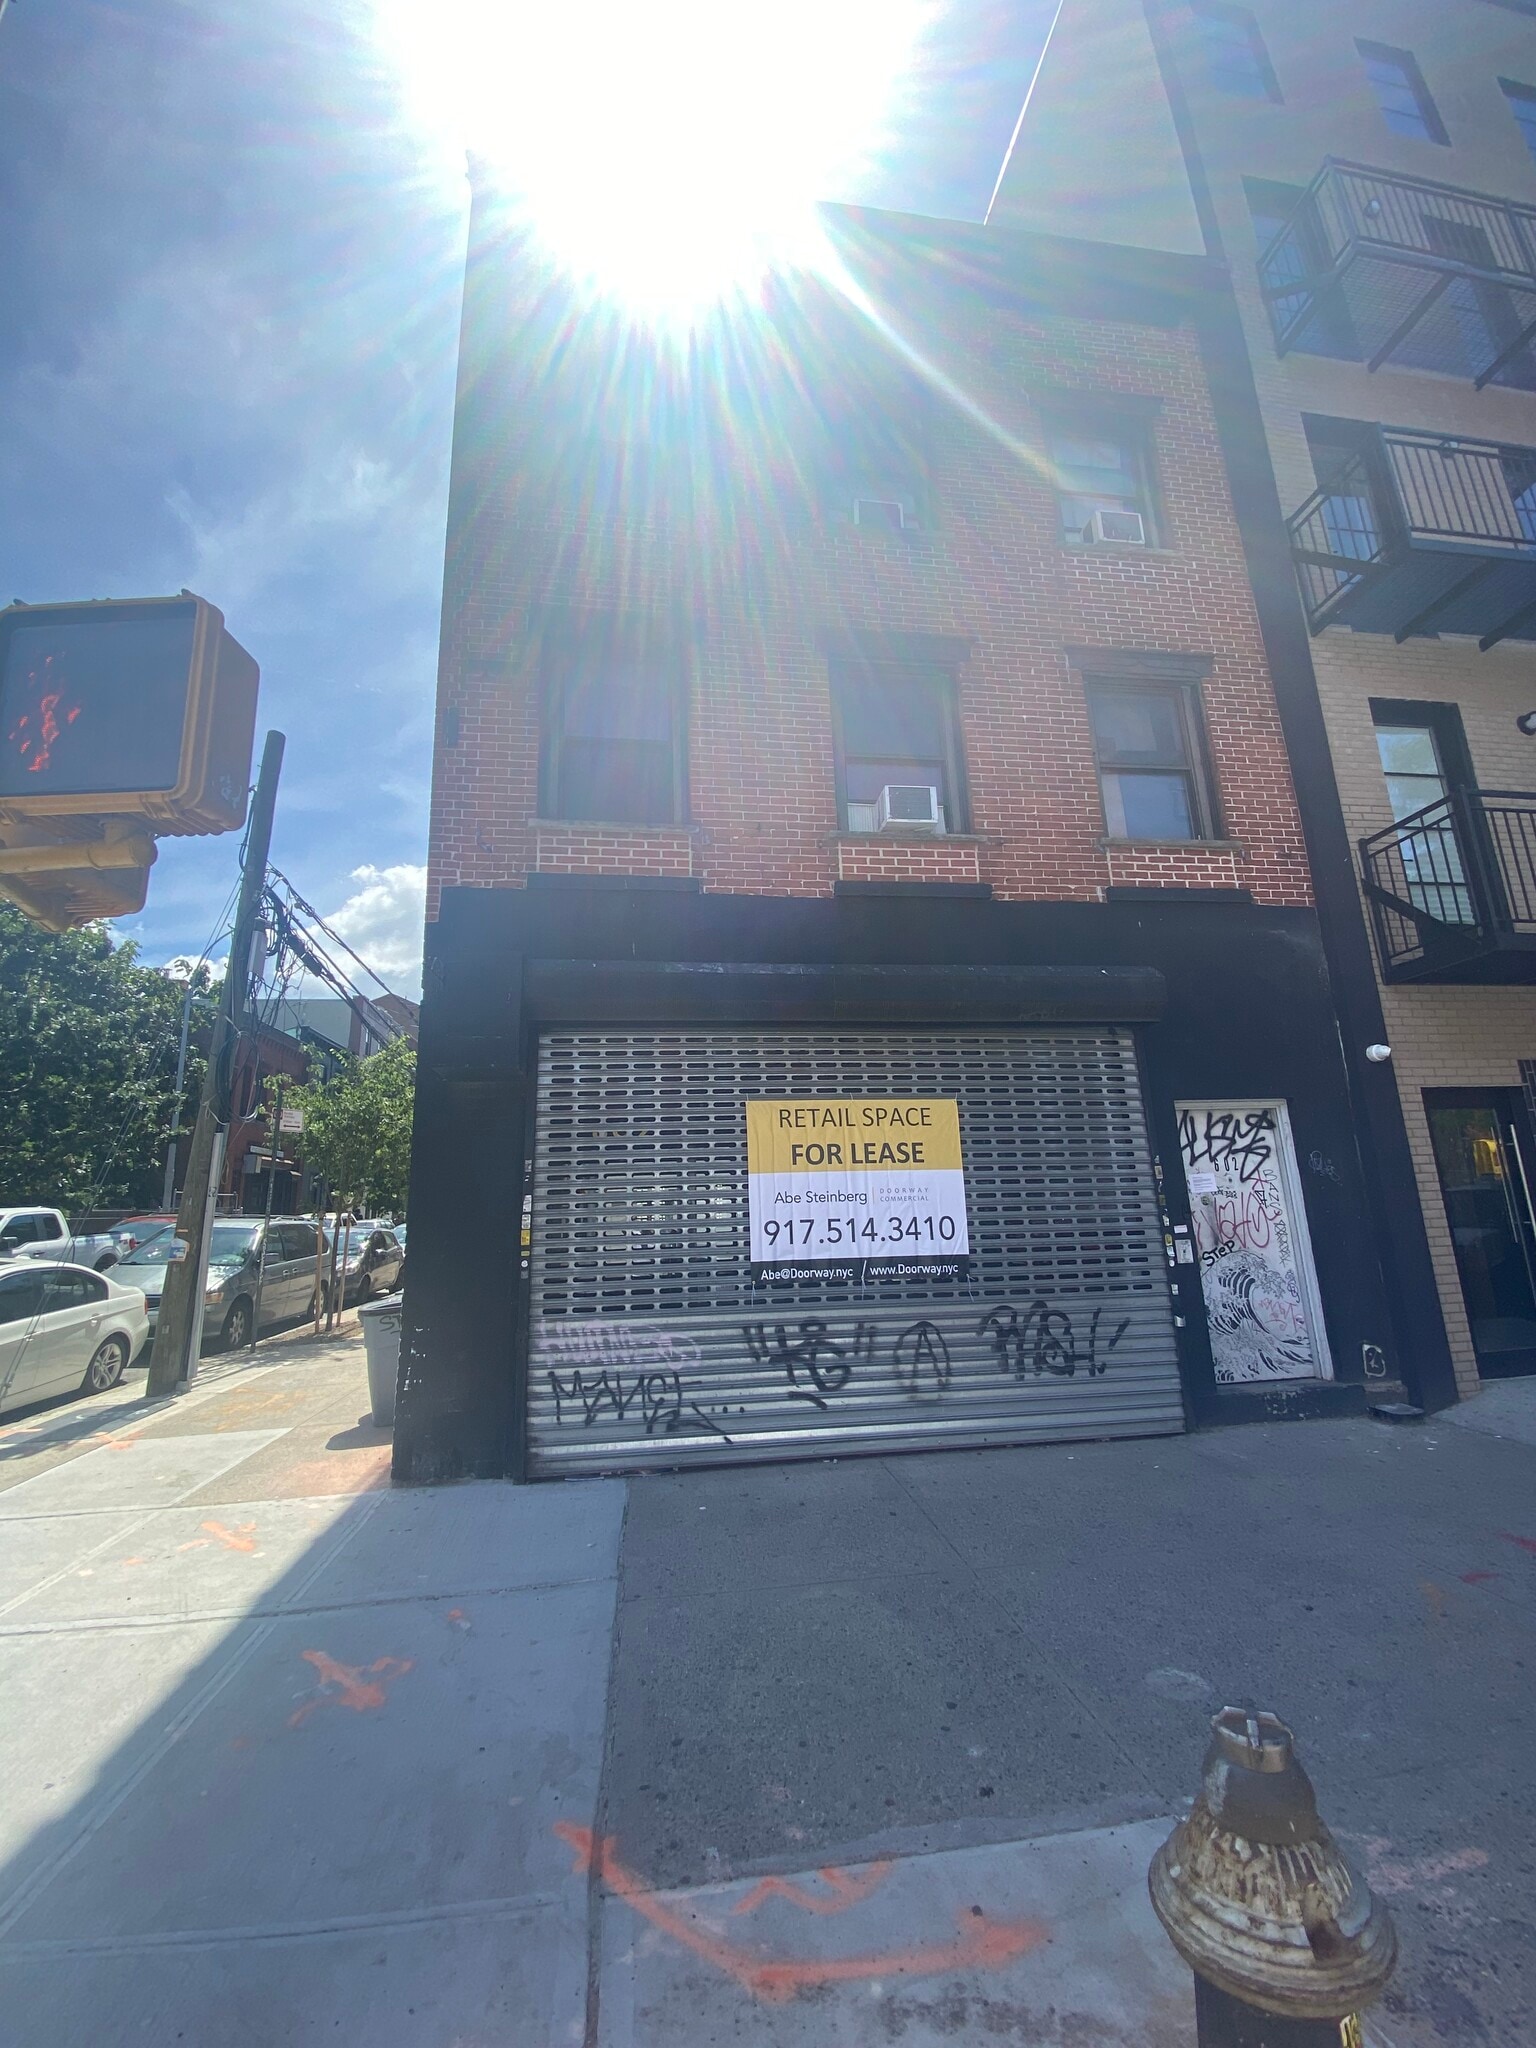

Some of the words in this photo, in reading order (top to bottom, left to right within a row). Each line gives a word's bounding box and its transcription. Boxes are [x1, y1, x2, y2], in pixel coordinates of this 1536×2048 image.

[779, 1108, 856, 1128] RETAIL
[862, 1107, 932, 1127] SPACE
[791, 1143, 843, 1165] FOR
[850, 1142, 925, 1164] LEASE
[774, 1190, 802, 1205] Abe
[805, 1189, 868, 1205] Steinberg
[763, 1215, 956, 1246] 917.514.3410
[760, 1267, 854, 1281] Abe@Doorway.nyc
[869, 1263, 959, 1276] www.Doorway.nyc
